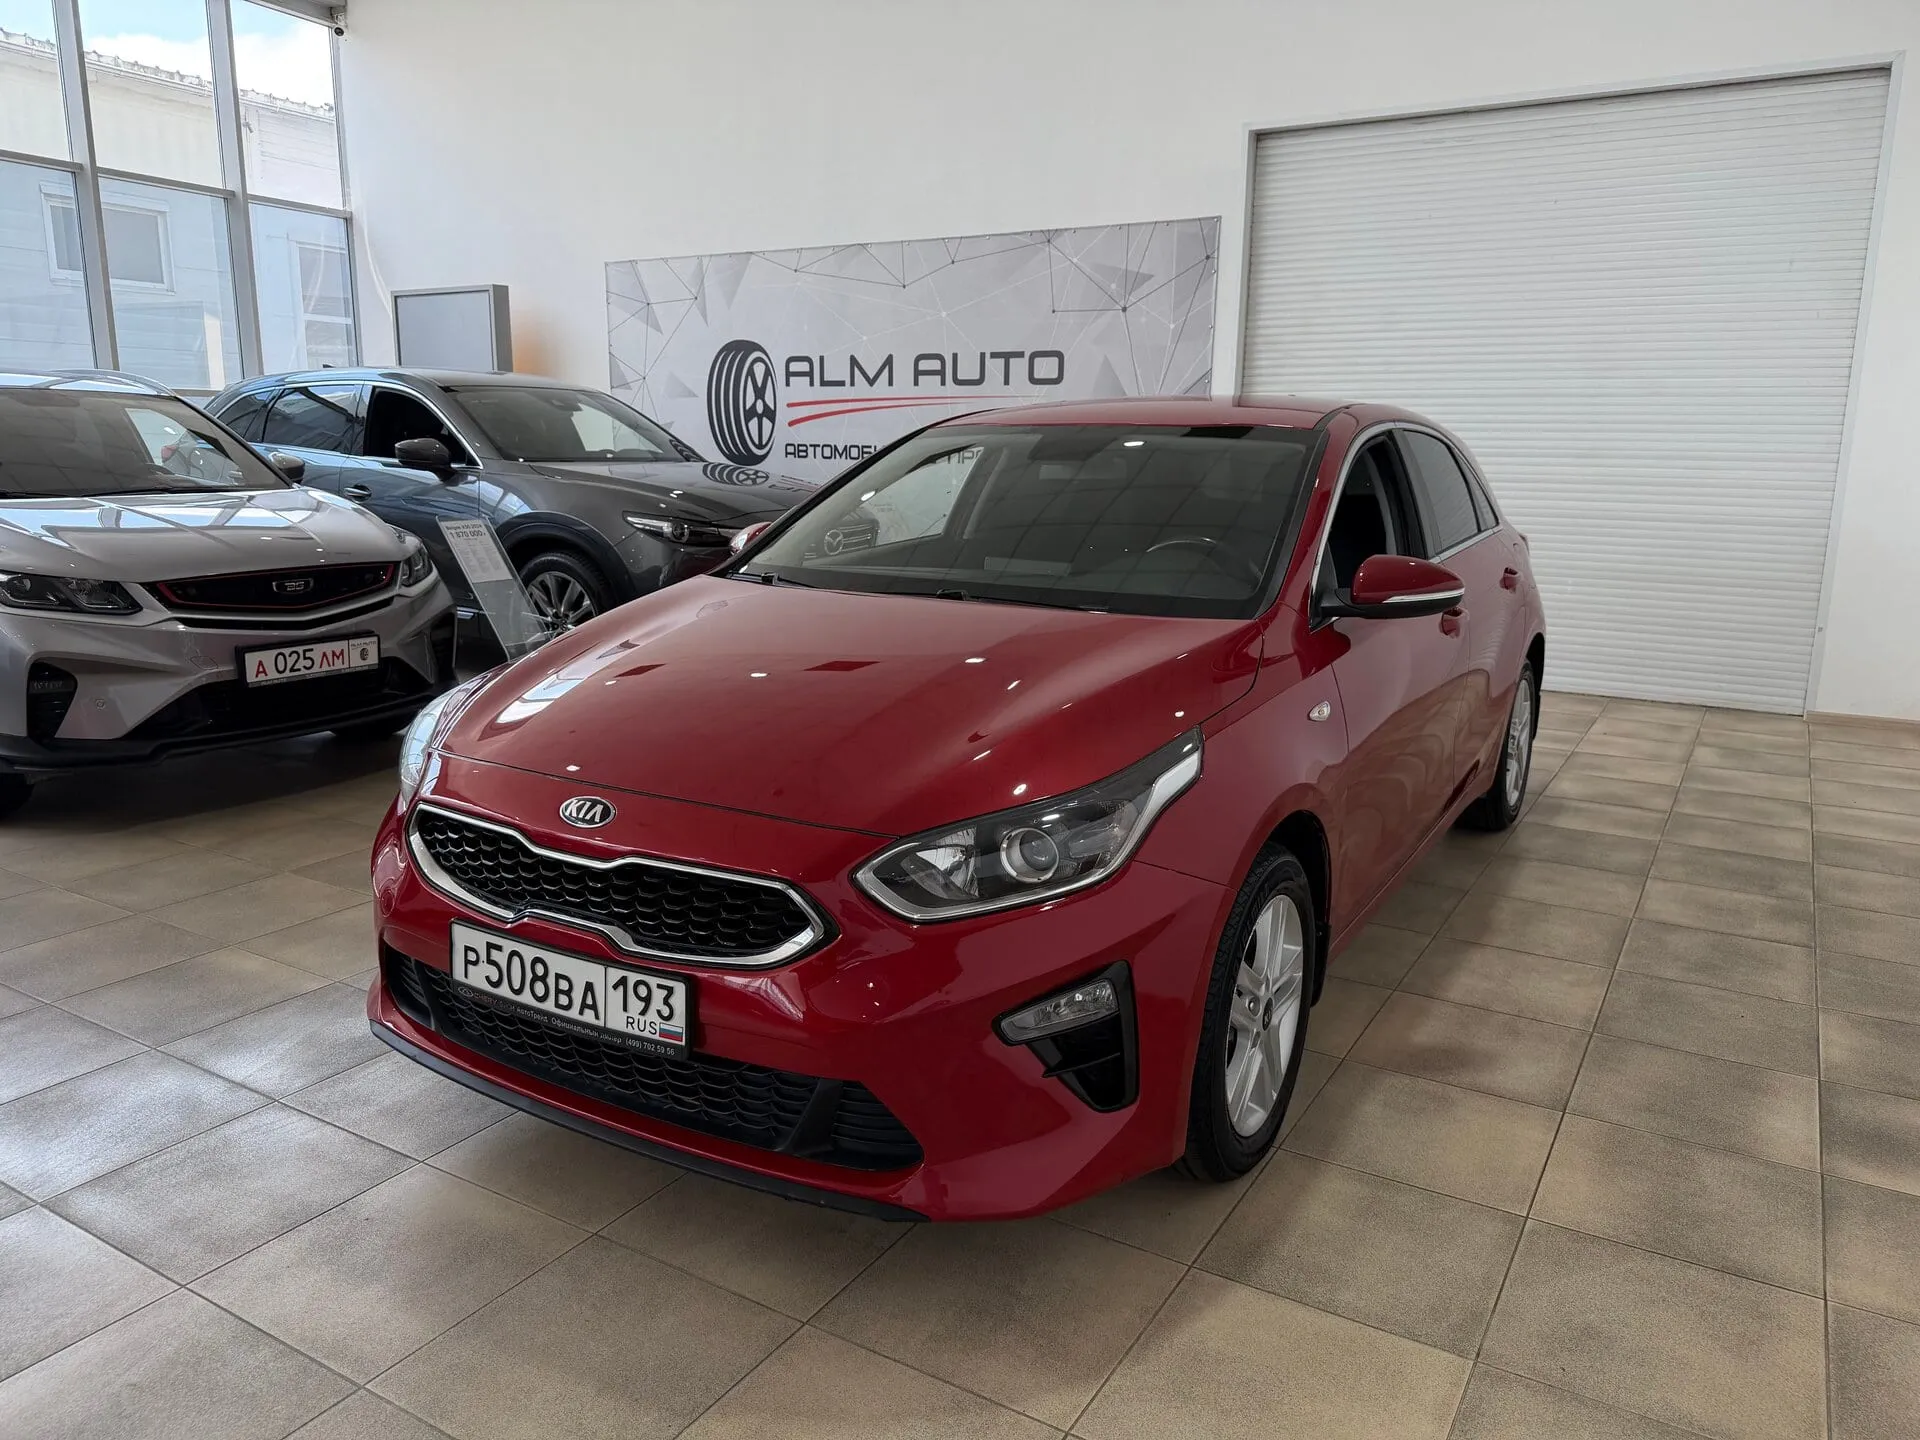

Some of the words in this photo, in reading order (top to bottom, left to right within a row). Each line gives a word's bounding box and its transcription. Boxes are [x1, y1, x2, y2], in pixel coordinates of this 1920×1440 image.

[785, 353, 894, 388] ALM
[913, 350, 1065, 387] AUTO
[274, 648, 315, 675] 025
[564, 799, 604, 823] KIA
[463, 941, 600, 1020] Р508ВА
[611, 975, 675, 1021] 193
[625, 1016, 657, 1036] RUS
